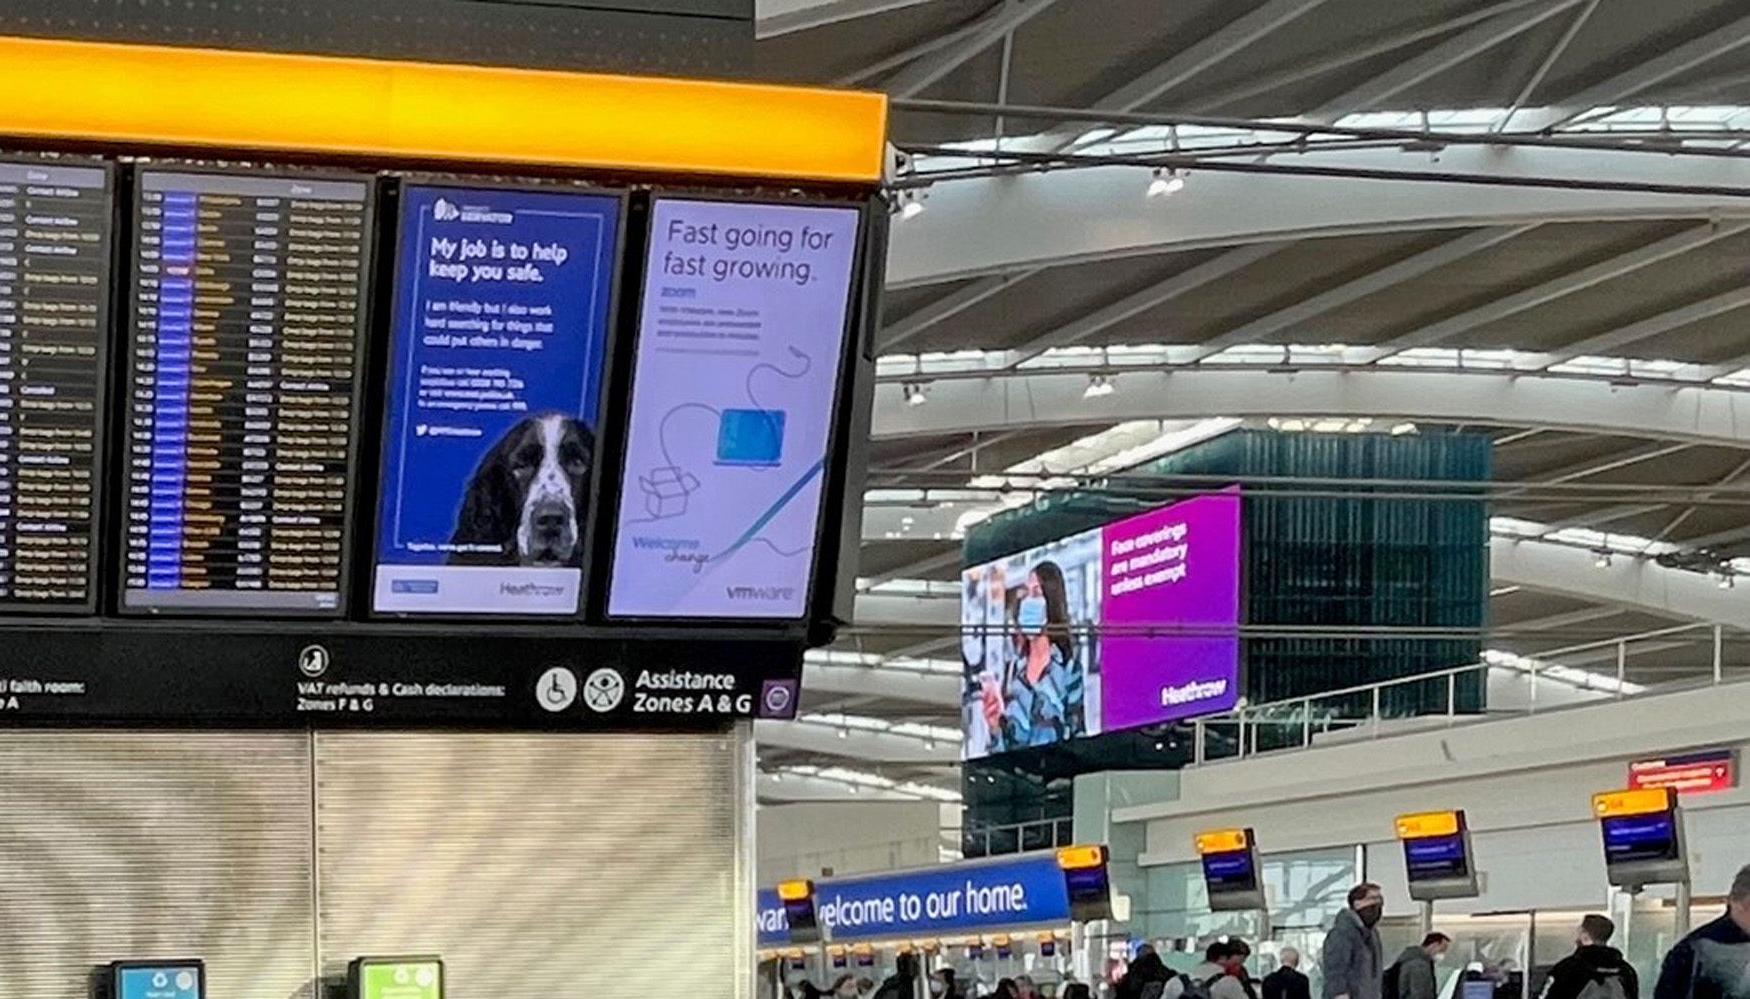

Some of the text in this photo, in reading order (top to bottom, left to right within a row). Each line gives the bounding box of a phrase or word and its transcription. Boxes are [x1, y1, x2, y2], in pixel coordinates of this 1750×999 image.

[668, 219, 834, 253] Fast going for
[431, 238, 567, 265] My job is to help
[430, 261, 543, 282] keep you safe.
[663, 251, 818, 286] fast growing.
[10, 680, 42, 694] faith
[45, 682, 85, 694] room:
[297, 682, 506, 697] VAT refunds & Cash declarations:
[636, 670, 736, 690] Assistance
[6, 698, 19, 709] A
[634, 693, 752, 714] Zones A & G
[899, 893, 921, 922] to
[926, 889, 958, 919] our
[967, 880, 1029, 914] home.
